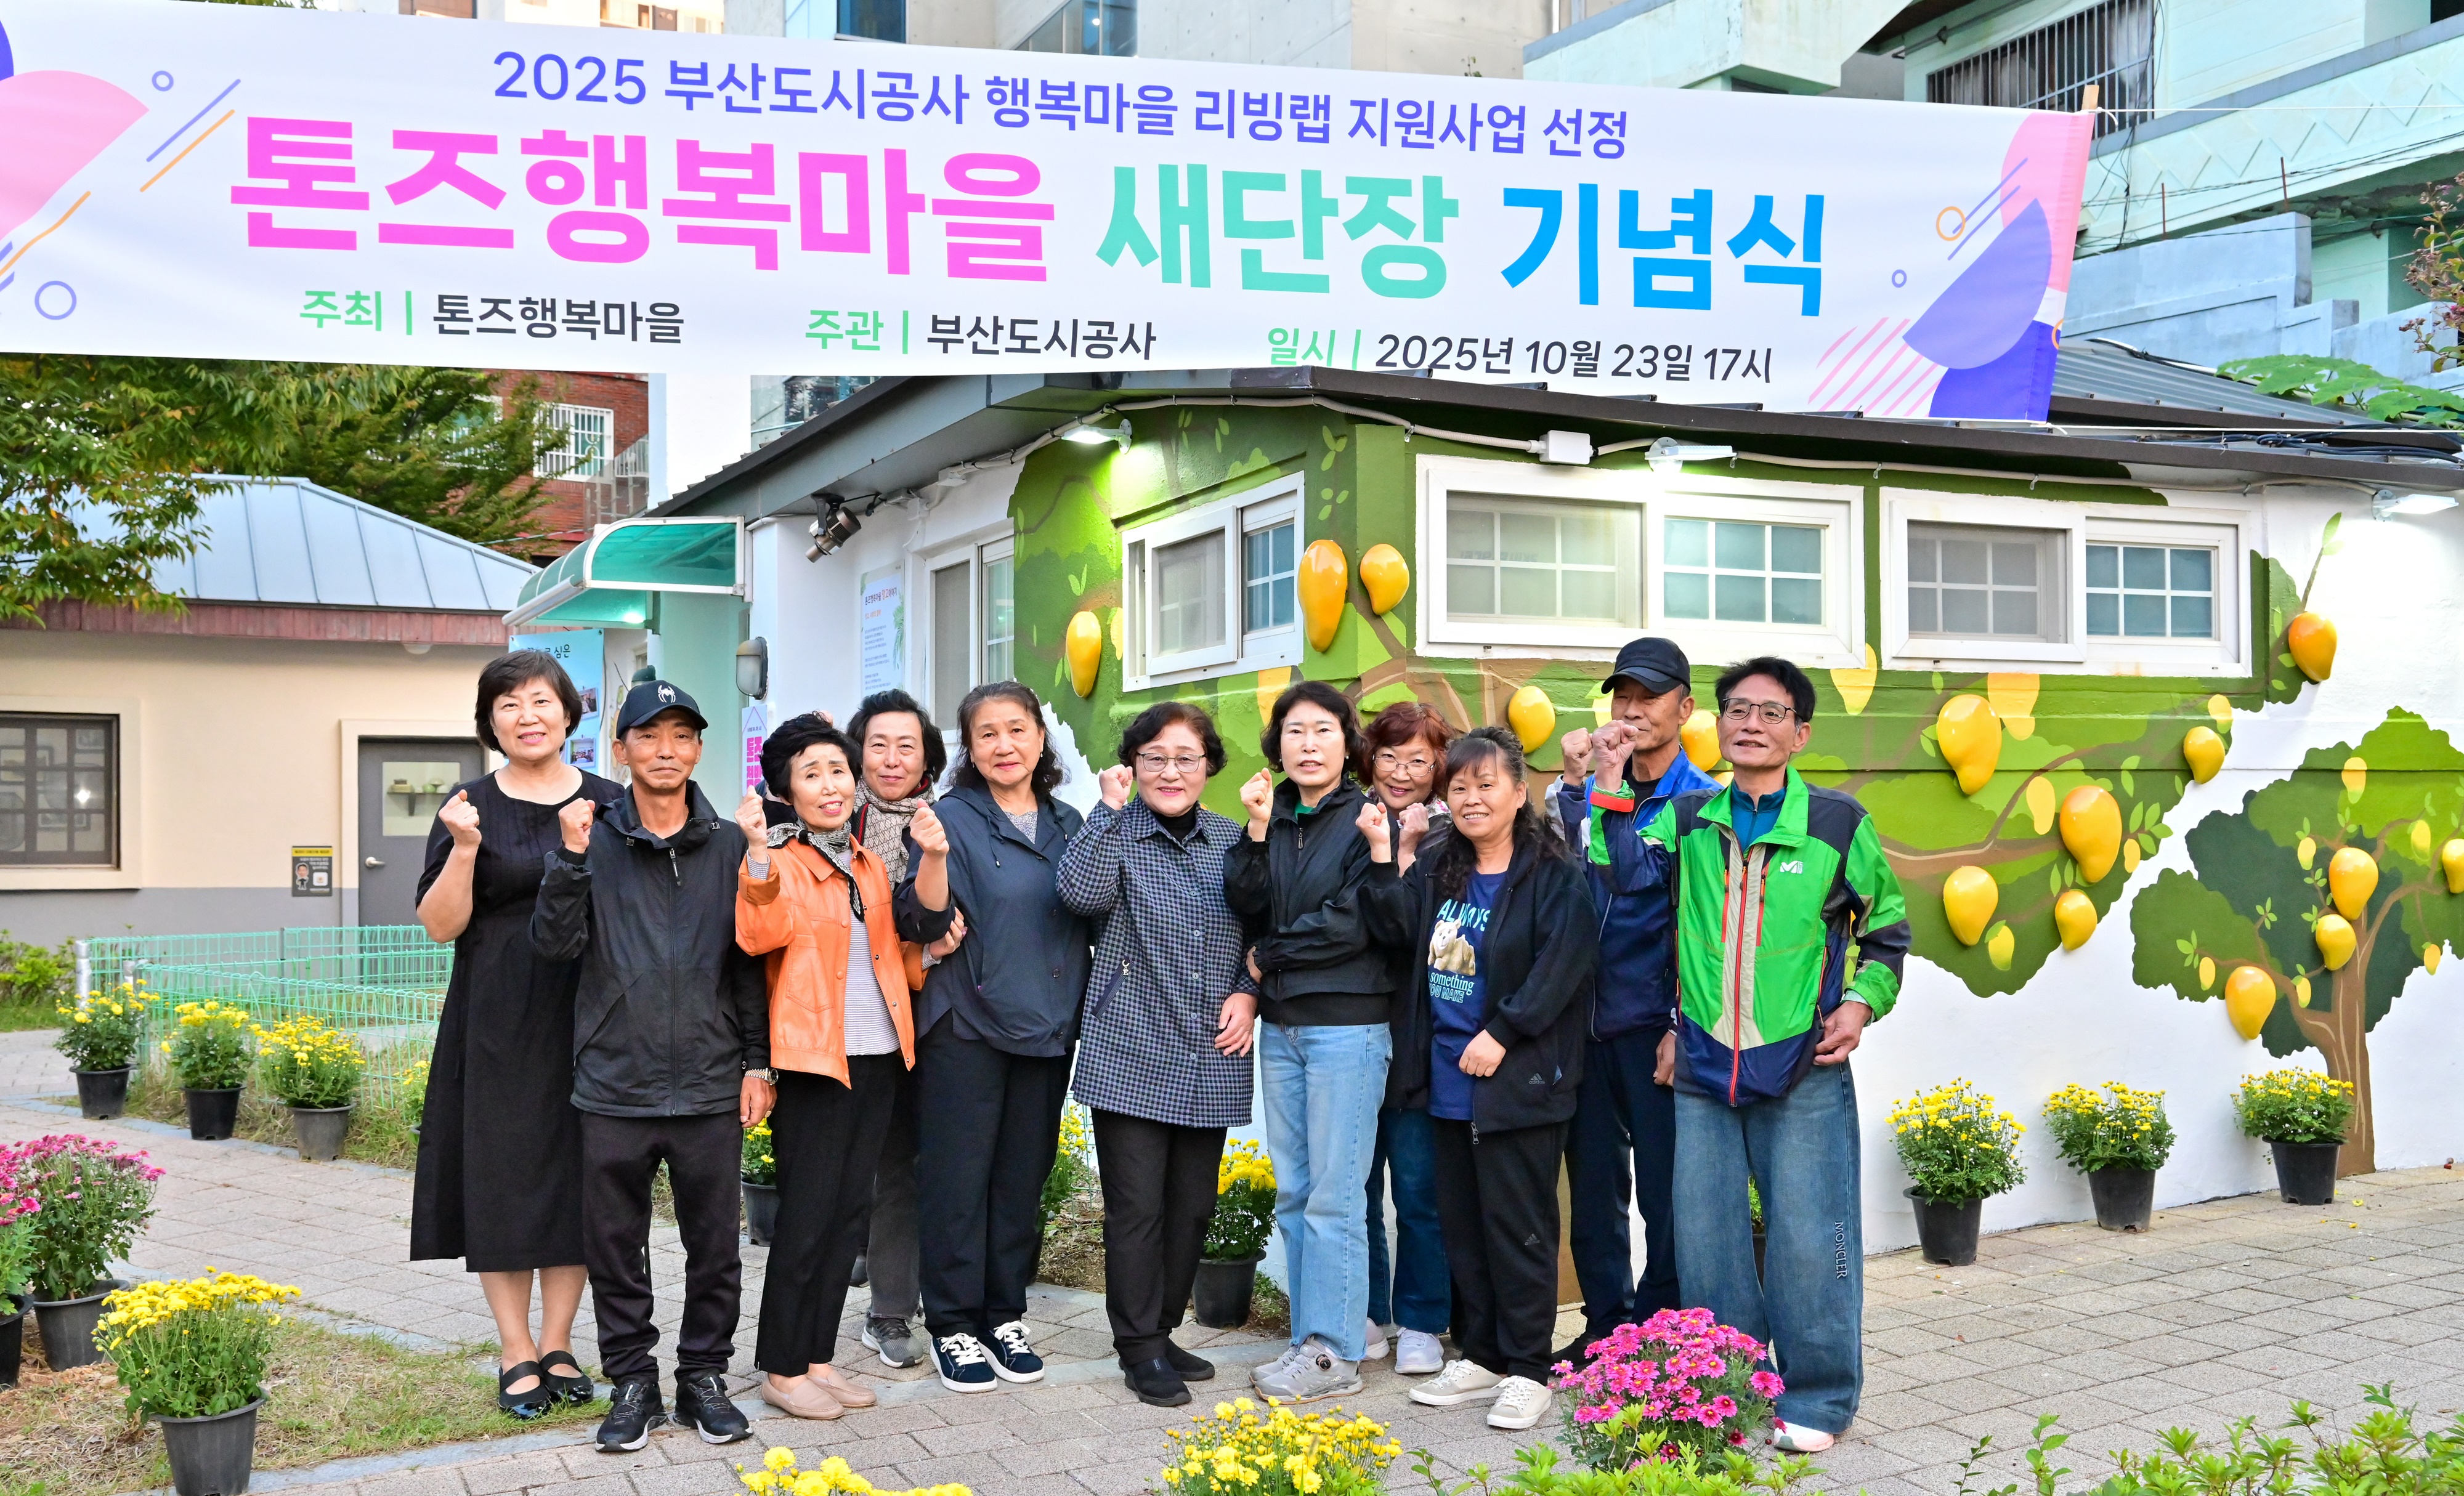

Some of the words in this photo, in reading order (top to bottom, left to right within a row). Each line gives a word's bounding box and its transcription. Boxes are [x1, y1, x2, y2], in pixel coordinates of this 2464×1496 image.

[494, 52, 646, 105] 2025
[665, 60, 970, 124] 부산도시공사
[986, 76, 1178, 136] 행복마을
[1196, 89, 1331, 144] 리빙랩
[1348, 98, 1525, 153] 지원사업
[1543, 108, 1627, 159] 선정
[231, 117, 1054, 281] 톤즈행복마을
[1096, 163, 1459, 299] 새단장
[1501, 183, 1824, 316] 기념식
[300, 291, 382, 331] 주최
[433, 294, 684, 344] 톤즈행복마을
[805, 310, 884, 351] 주관
[927, 315, 1157, 360] 부산도시공사
[1268, 328, 1336, 366] 일시
[1376, 334, 1514, 374] 2025년
[1526, 340, 1602, 378] 10월
[1611, 344, 1693, 382] 23일
[1704, 348, 1772, 384] 17시
[554, 644, 570, 658] 심은
[747, 736, 763, 763] 톤즈
[1436, 899, 1491, 932] ALWAYS
[1430, 971, 1475, 996] something
[1441, 987, 1465, 1004] MAKE
[1834, 1221, 1848, 1279] MONCLER
